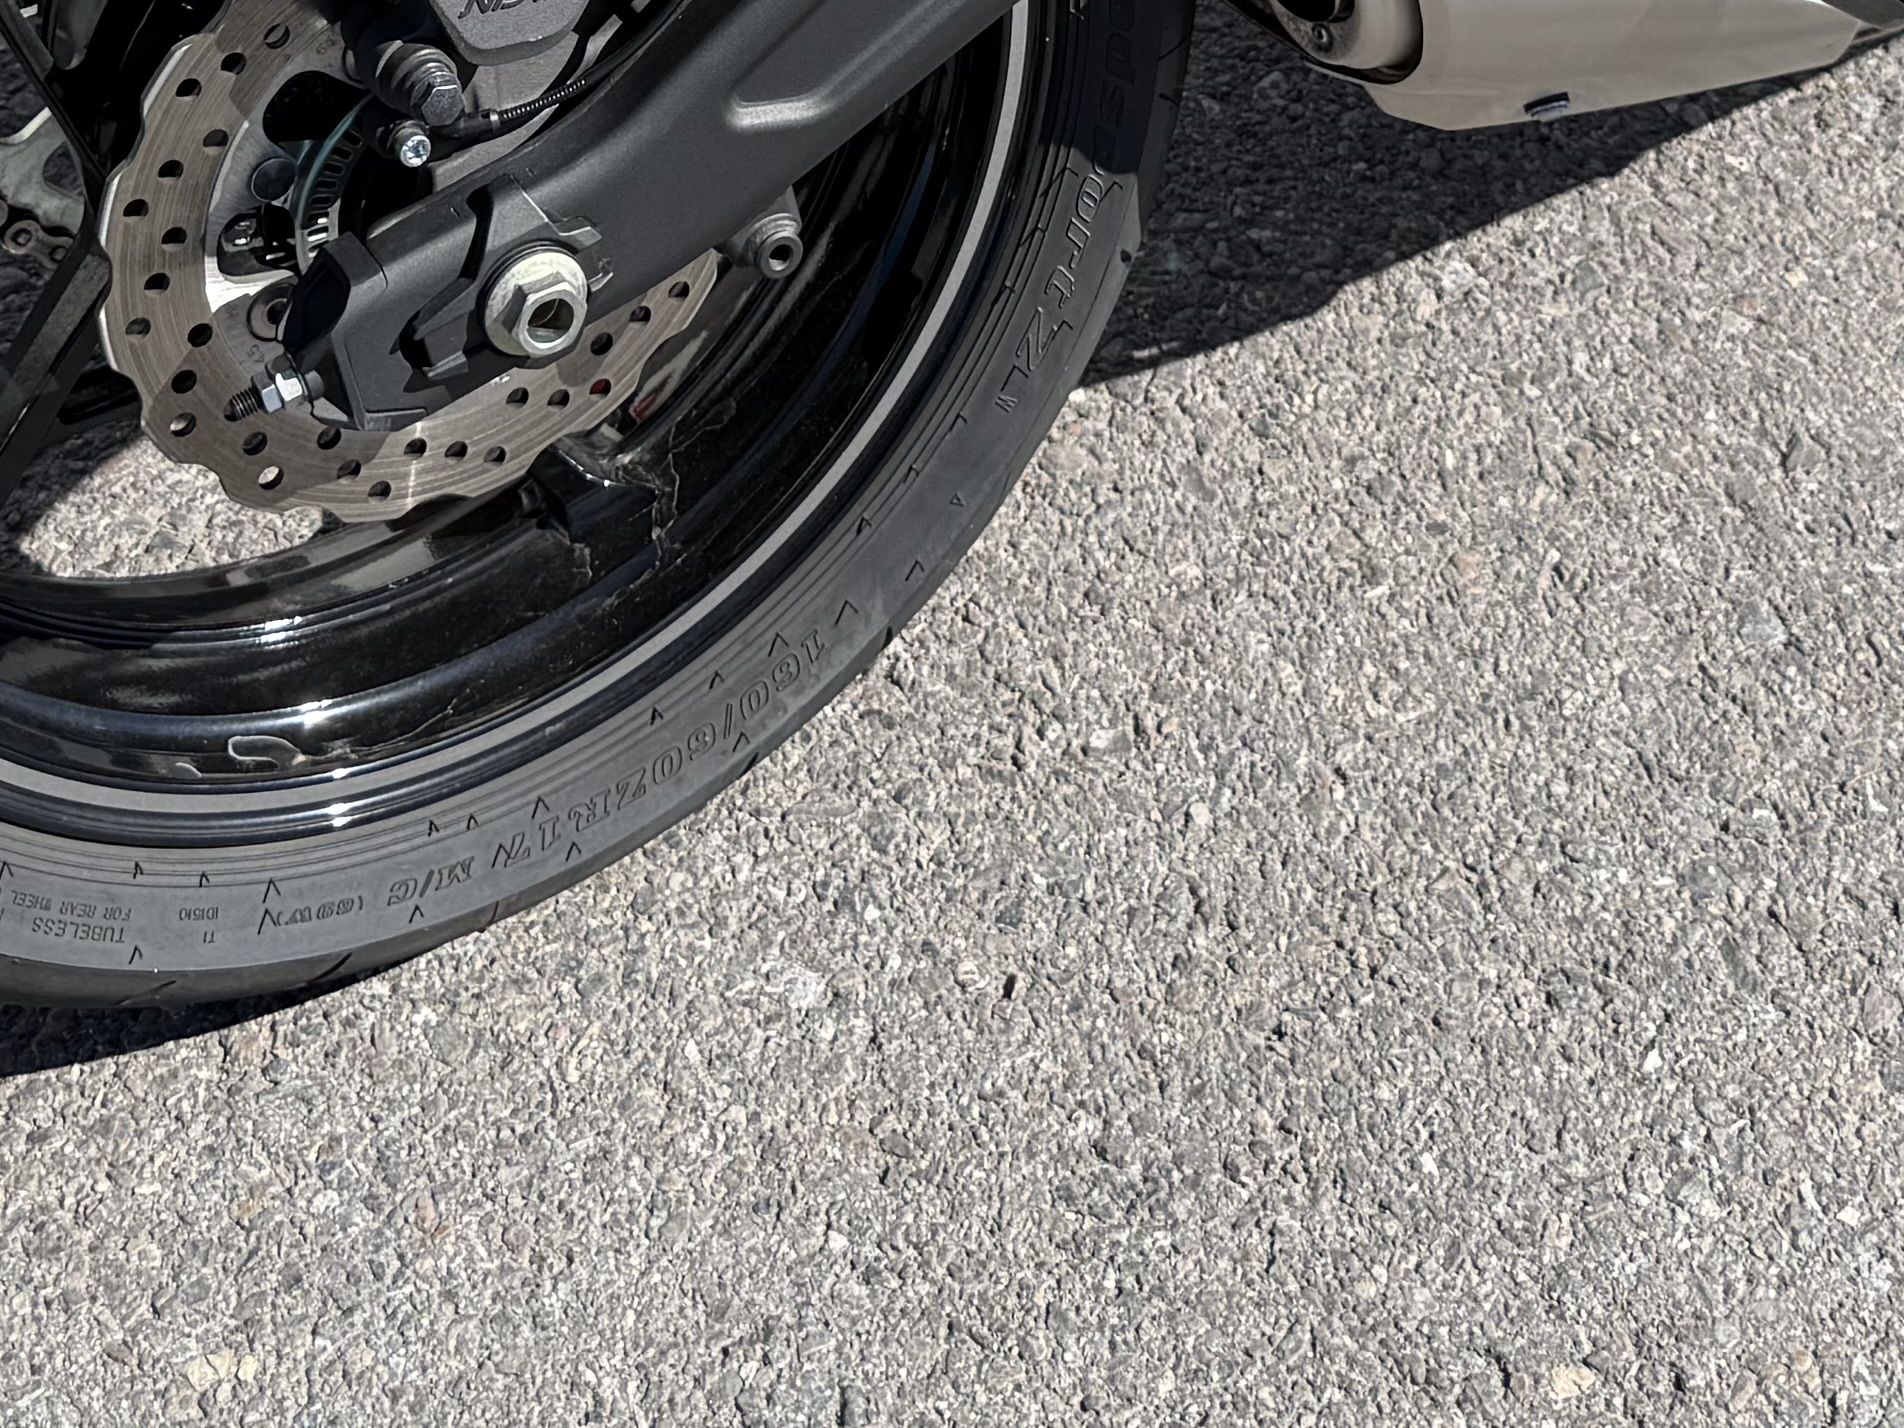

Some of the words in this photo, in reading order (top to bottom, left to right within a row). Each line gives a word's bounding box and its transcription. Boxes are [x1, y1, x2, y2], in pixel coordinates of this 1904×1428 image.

[59, 900, 98, 919] REAR
[102, 906, 133, 922] FOR
[31, 917, 126, 944] TUBELESS
